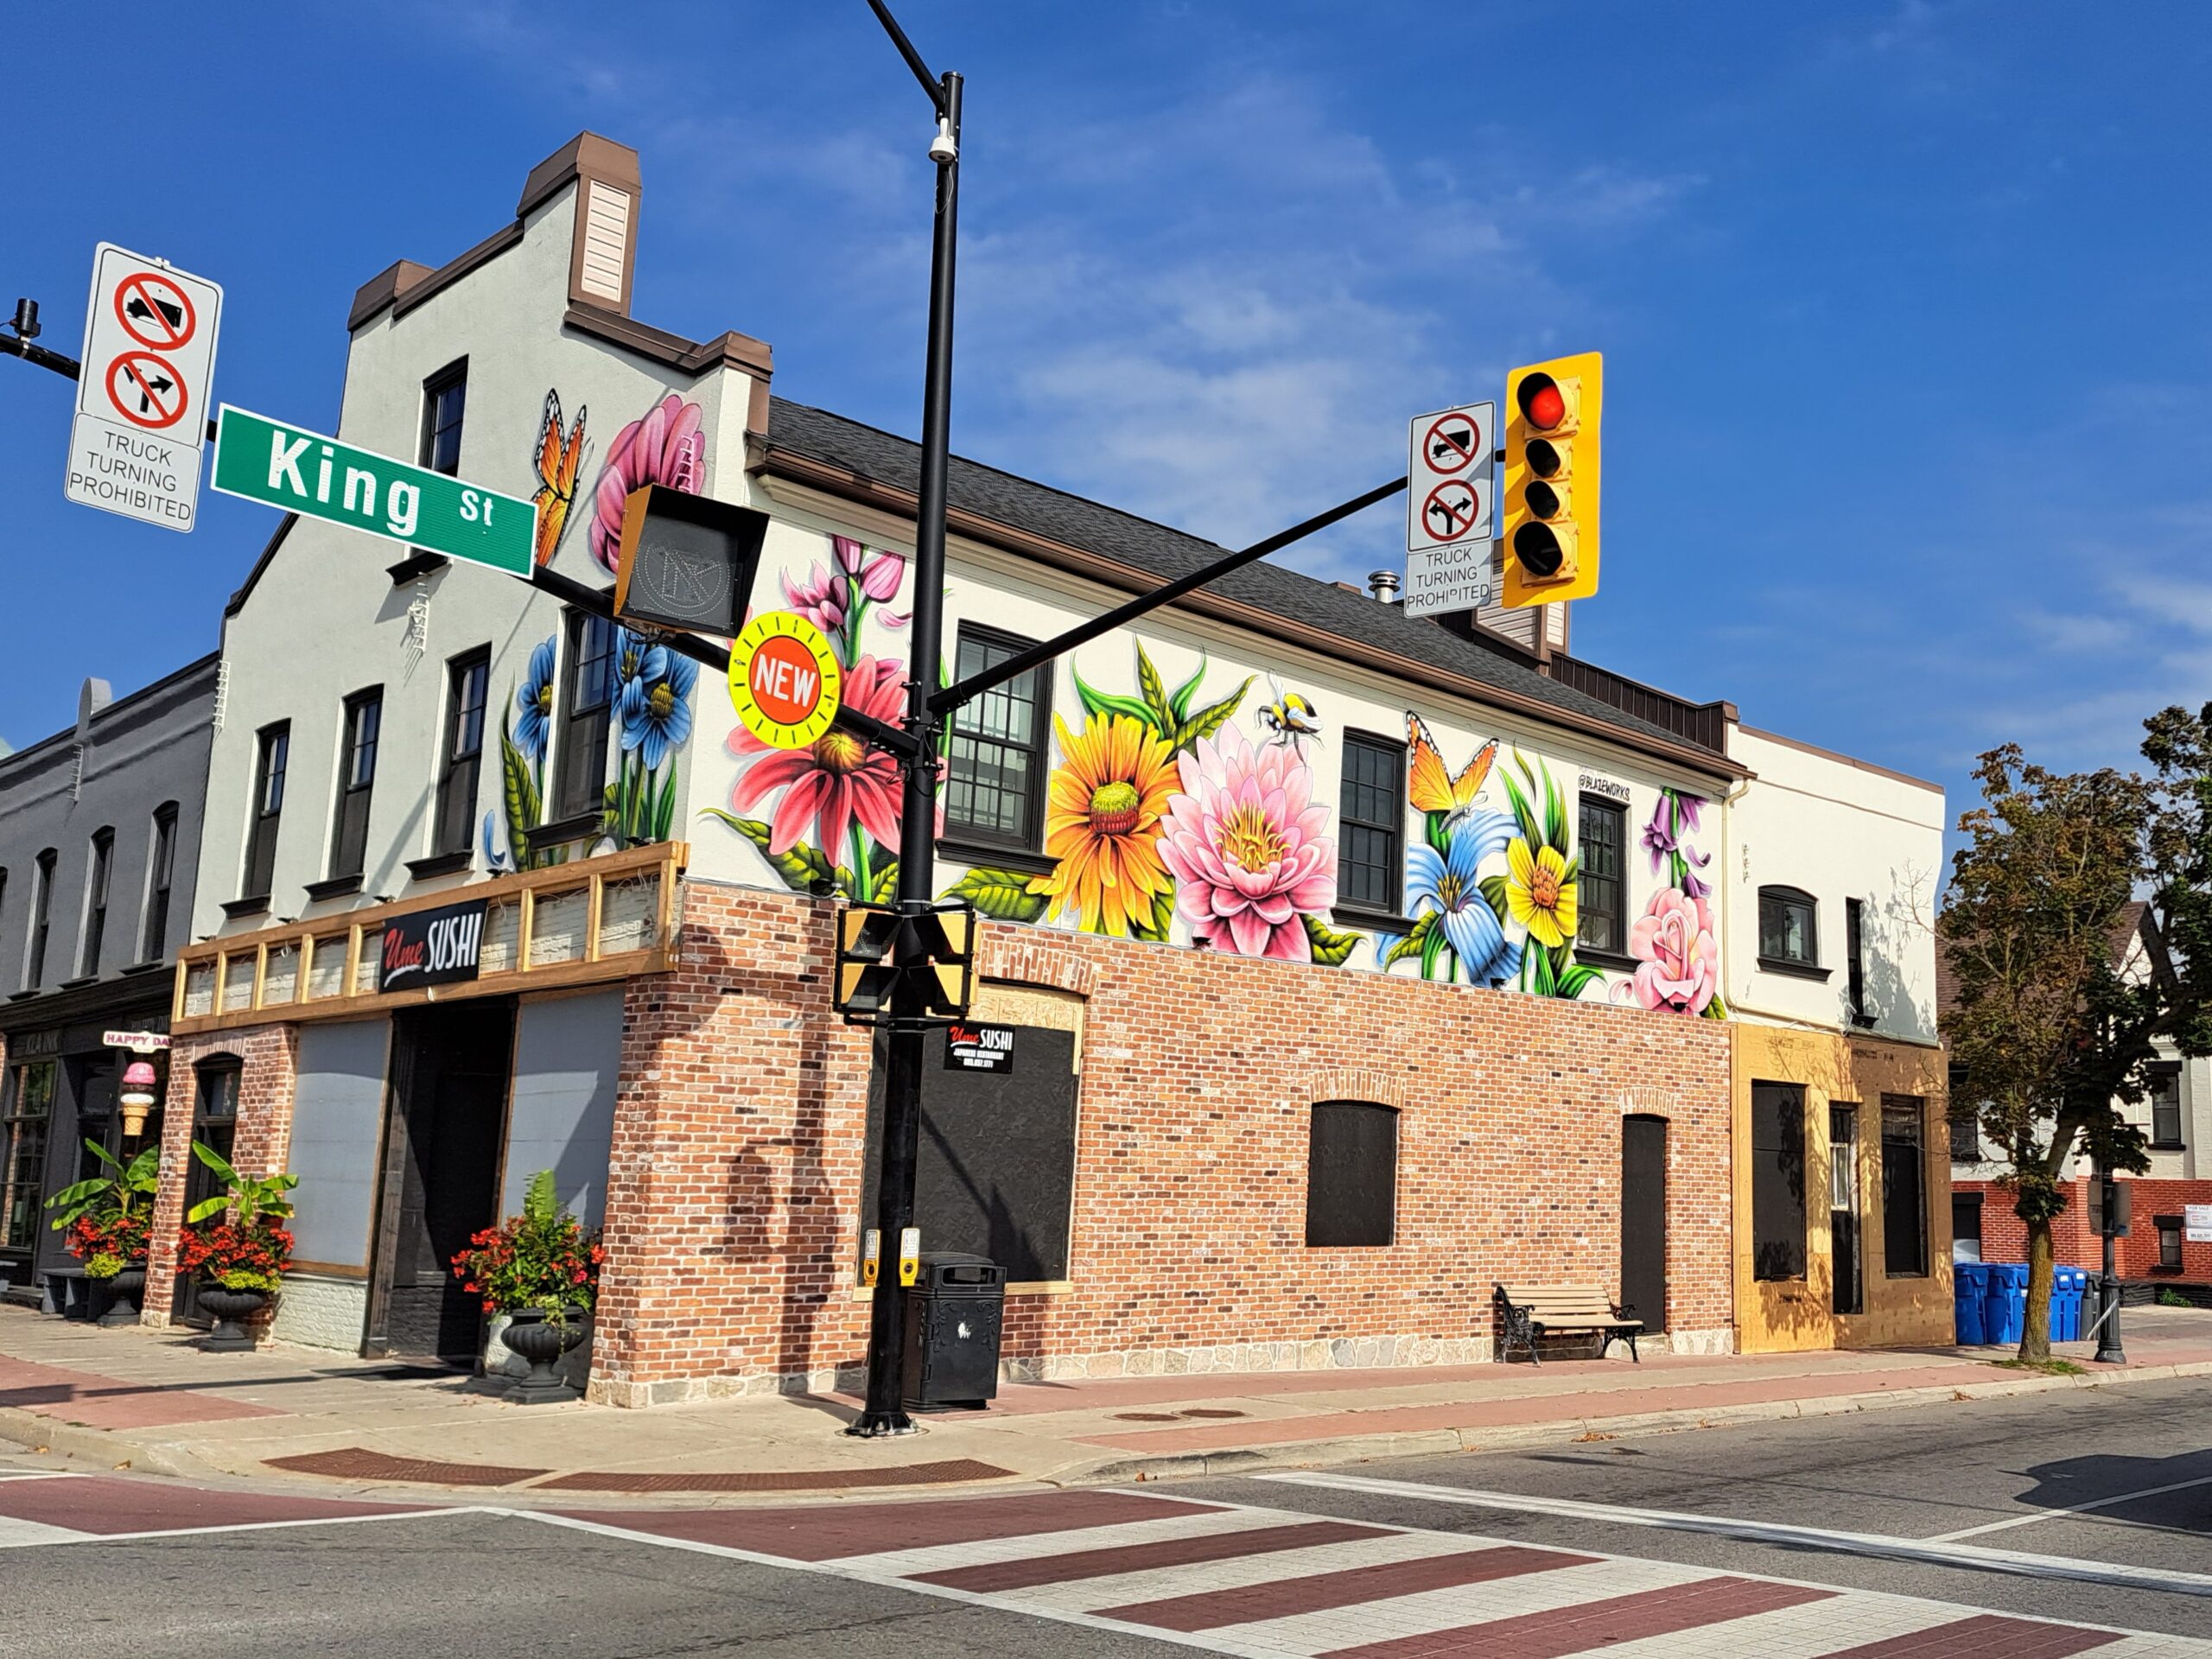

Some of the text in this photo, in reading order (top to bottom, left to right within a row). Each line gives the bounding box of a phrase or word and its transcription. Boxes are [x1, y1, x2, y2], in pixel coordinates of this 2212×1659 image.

[105, 431, 172, 467] TRUCK
[87, 451, 176, 493] TURNING
[268, 429, 493, 537] King St
[69, 472, 191, 520] PROHIBITED
[1426, 547, 1472, 567] TRUCK
[1416, 566, 1478, 588] TURNING
[754, 653, 816, 708] NEW
[1578, 774, 1630, 801] @BLAZEWORKS
[385, 912, 482, 973] Ume SUSHI
[106, 1033, 149, 1046] HAPPY
[950, 1026, 1013, 1051] Ume SUSHI
